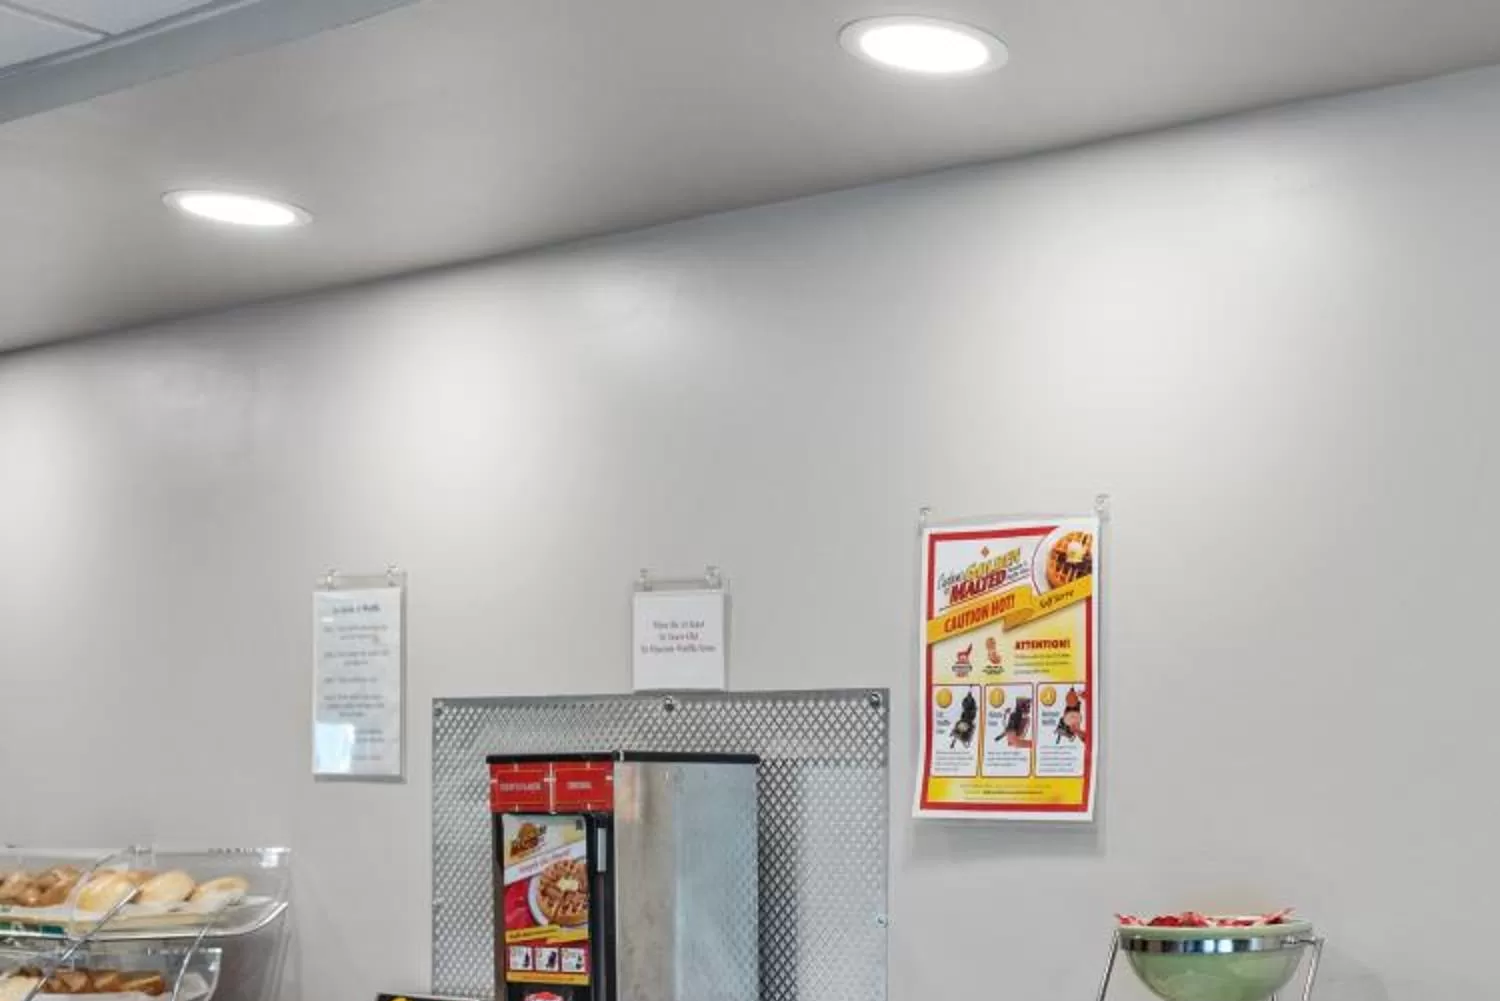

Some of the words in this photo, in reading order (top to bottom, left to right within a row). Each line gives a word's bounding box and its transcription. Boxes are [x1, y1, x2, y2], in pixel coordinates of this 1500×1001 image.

[950, 568, 1007, 605] MALTED
[944, 605, 990, 633] CAUTION
[991, 593, 1016, 617] HOT!
[1015, 639, 1071, 650] ATTENTION!
